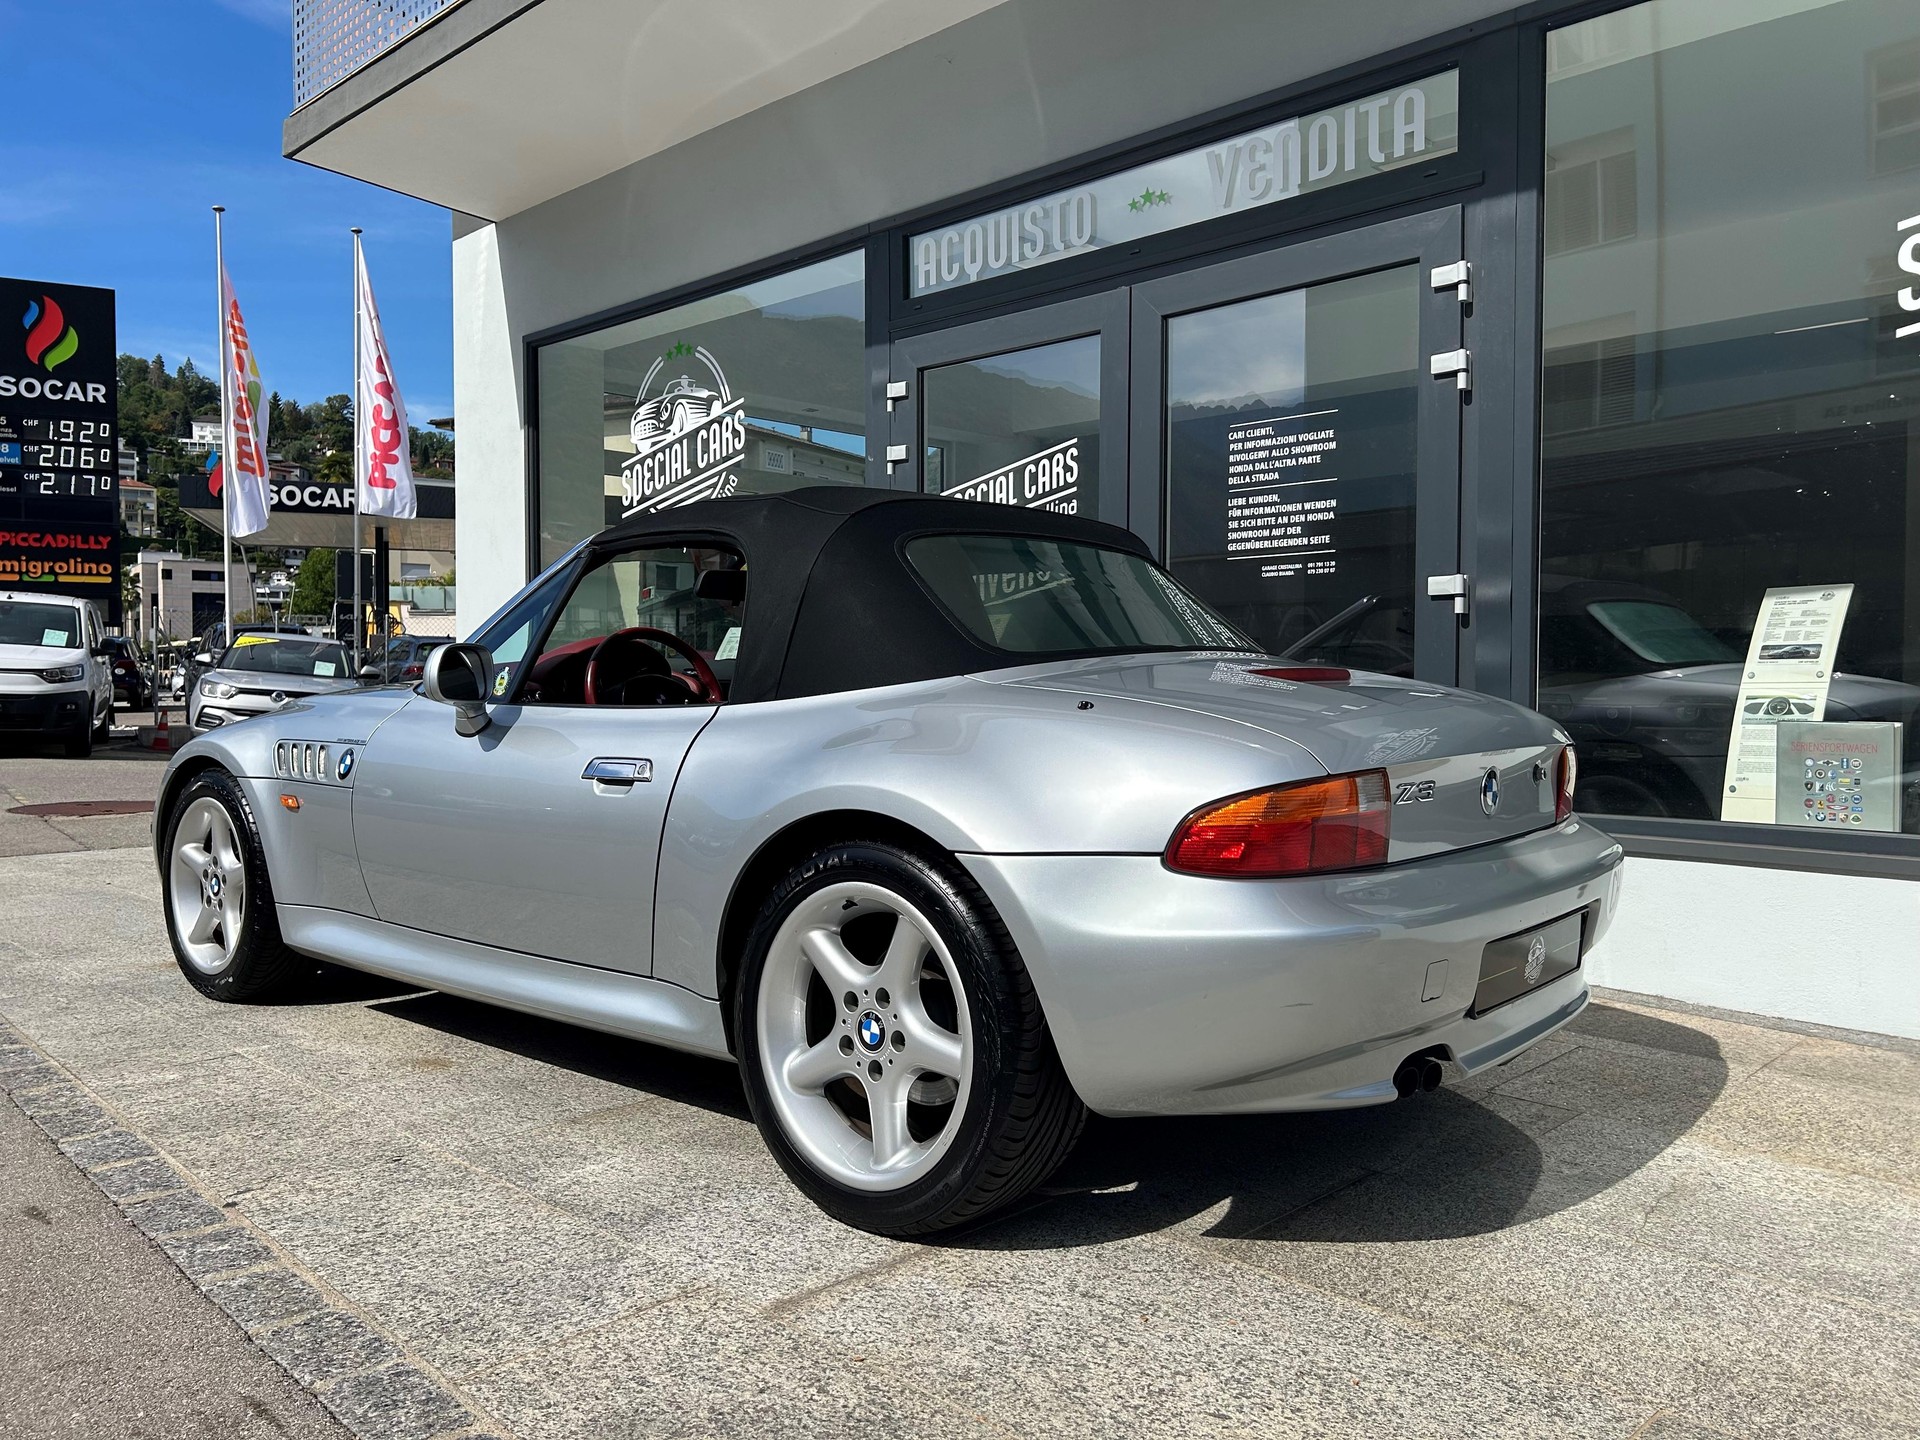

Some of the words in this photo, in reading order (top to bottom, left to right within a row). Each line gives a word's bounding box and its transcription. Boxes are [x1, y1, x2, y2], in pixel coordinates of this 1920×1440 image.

[1205, 88, 1426, 209] VENDITA
[918, 192, 1093, 289] ACQUISTO
[0, 375, 107, 404] SOCAR
[1228, 432, 1245, 440] CARI
[1246, 427, 1275, 438] CLIENTI,
[1229, 442, 1243, 451] PER
[1244, 434, 1297, 450] INFORMAZIONI
[1298, 429, 1335, 442] VOGLIATE
[23, 445, 40, 453] CHF
[621, 438, 692, 507] SPECIAL
[696, 409, 746, 469] CARS
[1229, 450, 1269, 462] RIVOLGERVI
[1271, 447, 1290, 457] ALLO
[1291, 441, 1337, 454] SHOWROOM
[1024, 447, 1079, 499] CARS
[1229, 464, 1253, 474] HONDA
[1298, 455, 1321, 465] PARTE
[1228, 474, 1251, 485] DELLA
[1251, 471, 1279, 482] STRADA
[1228, 497, 1247, 507] LIEBE
[1248, 494, 1280, 504] KUNDEN,
[1228, 508, 1242, 517] FÜR
[1242, 503, 1302, 516] INFORMATIONEN
[1303, 499, 1337, 510] WENDEN
[1228, 520, 1239, 529] SIE
[1240, 519, 1256, 528] SICH
[1257, 517, 1276, 526] BITTE
[1277, 515, 1288, 524] AN
[1290, 514, 1305, 523] DEN
[1307, 511, 1335, 521] HONDA
[1227, 529, 1270, 540] SHOWROOM
[1271, 527, 1285, 536] AUF
[1287, 526, 1302, 535] DER
[1227, 537, 1308, 551] GEGENÜBERLIEGENDEN
[1309, 535, 1330, 545] SEITE
[0, 555, 112, 578] migrolino
[1791, 741, 1878, 754] SERIENSPORTWAGEN
[1394, 780, 1437, 805] Z3
